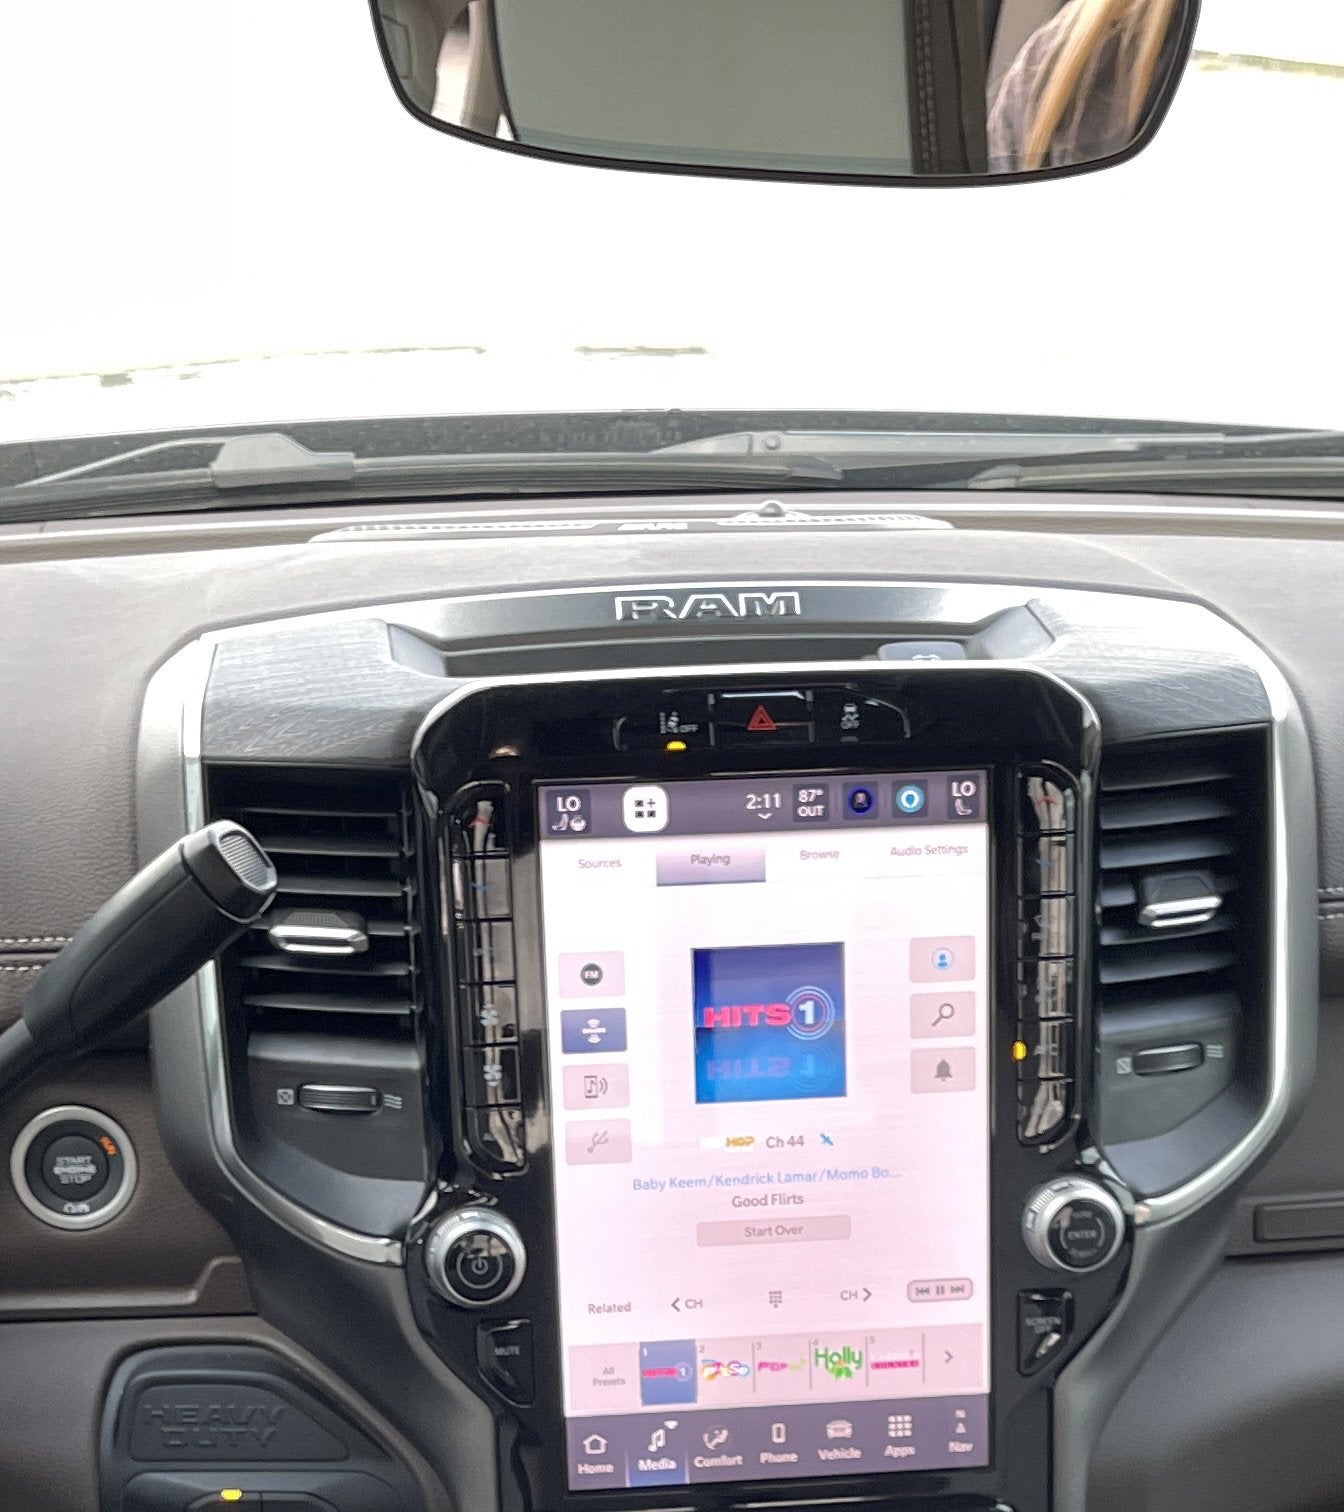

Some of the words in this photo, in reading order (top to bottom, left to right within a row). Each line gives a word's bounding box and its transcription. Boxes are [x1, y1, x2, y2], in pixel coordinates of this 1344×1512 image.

[614, 591, 801, 621] RAM
[951, 781, 975, 797] LO
[556, 796, 581, 813] LO
[745, 793, 782, 811] 2:11
[797, 804, 824, 818] OUT
[799, 848, 840, 862] Browse
[889, 845, 921, 858] Audio
[924, 842, 969, 860] Settings
[577, 857, 622, 872] Sources
[690, 853, 731, 869] Playing
[704, 1002, 792, 1028] HITS
[765, 1136, 784, 1149] Ch
[786, 1135, 805, 1147] 44
[632, 1178, 666, 1194] Baby
[731, 1193, 768, 1209] Good
[770, 1191, 805, 1207] Flirts
[744, 1224, 771, 1238] Start
[774, 1223, 804, 1237] Over
[840, 1288, 858, 1302] CH
[587, 1300, 632, 1315] Related
[684, 1298, 703, 1311] CH
[814, 1345, 863, 1370] Holly
[592, 1376, 626, 1388] Presets
[759, 1452, 799, 1464] Phone
[818, 1447, 863, 1460] Vehicle
[883, 1445, 917, 1459] Apps
[577, 1462, 615, 1475] Home
[638, 1457, 678, 1471] Media
[693, 1454, 744, 1469] Comfort
